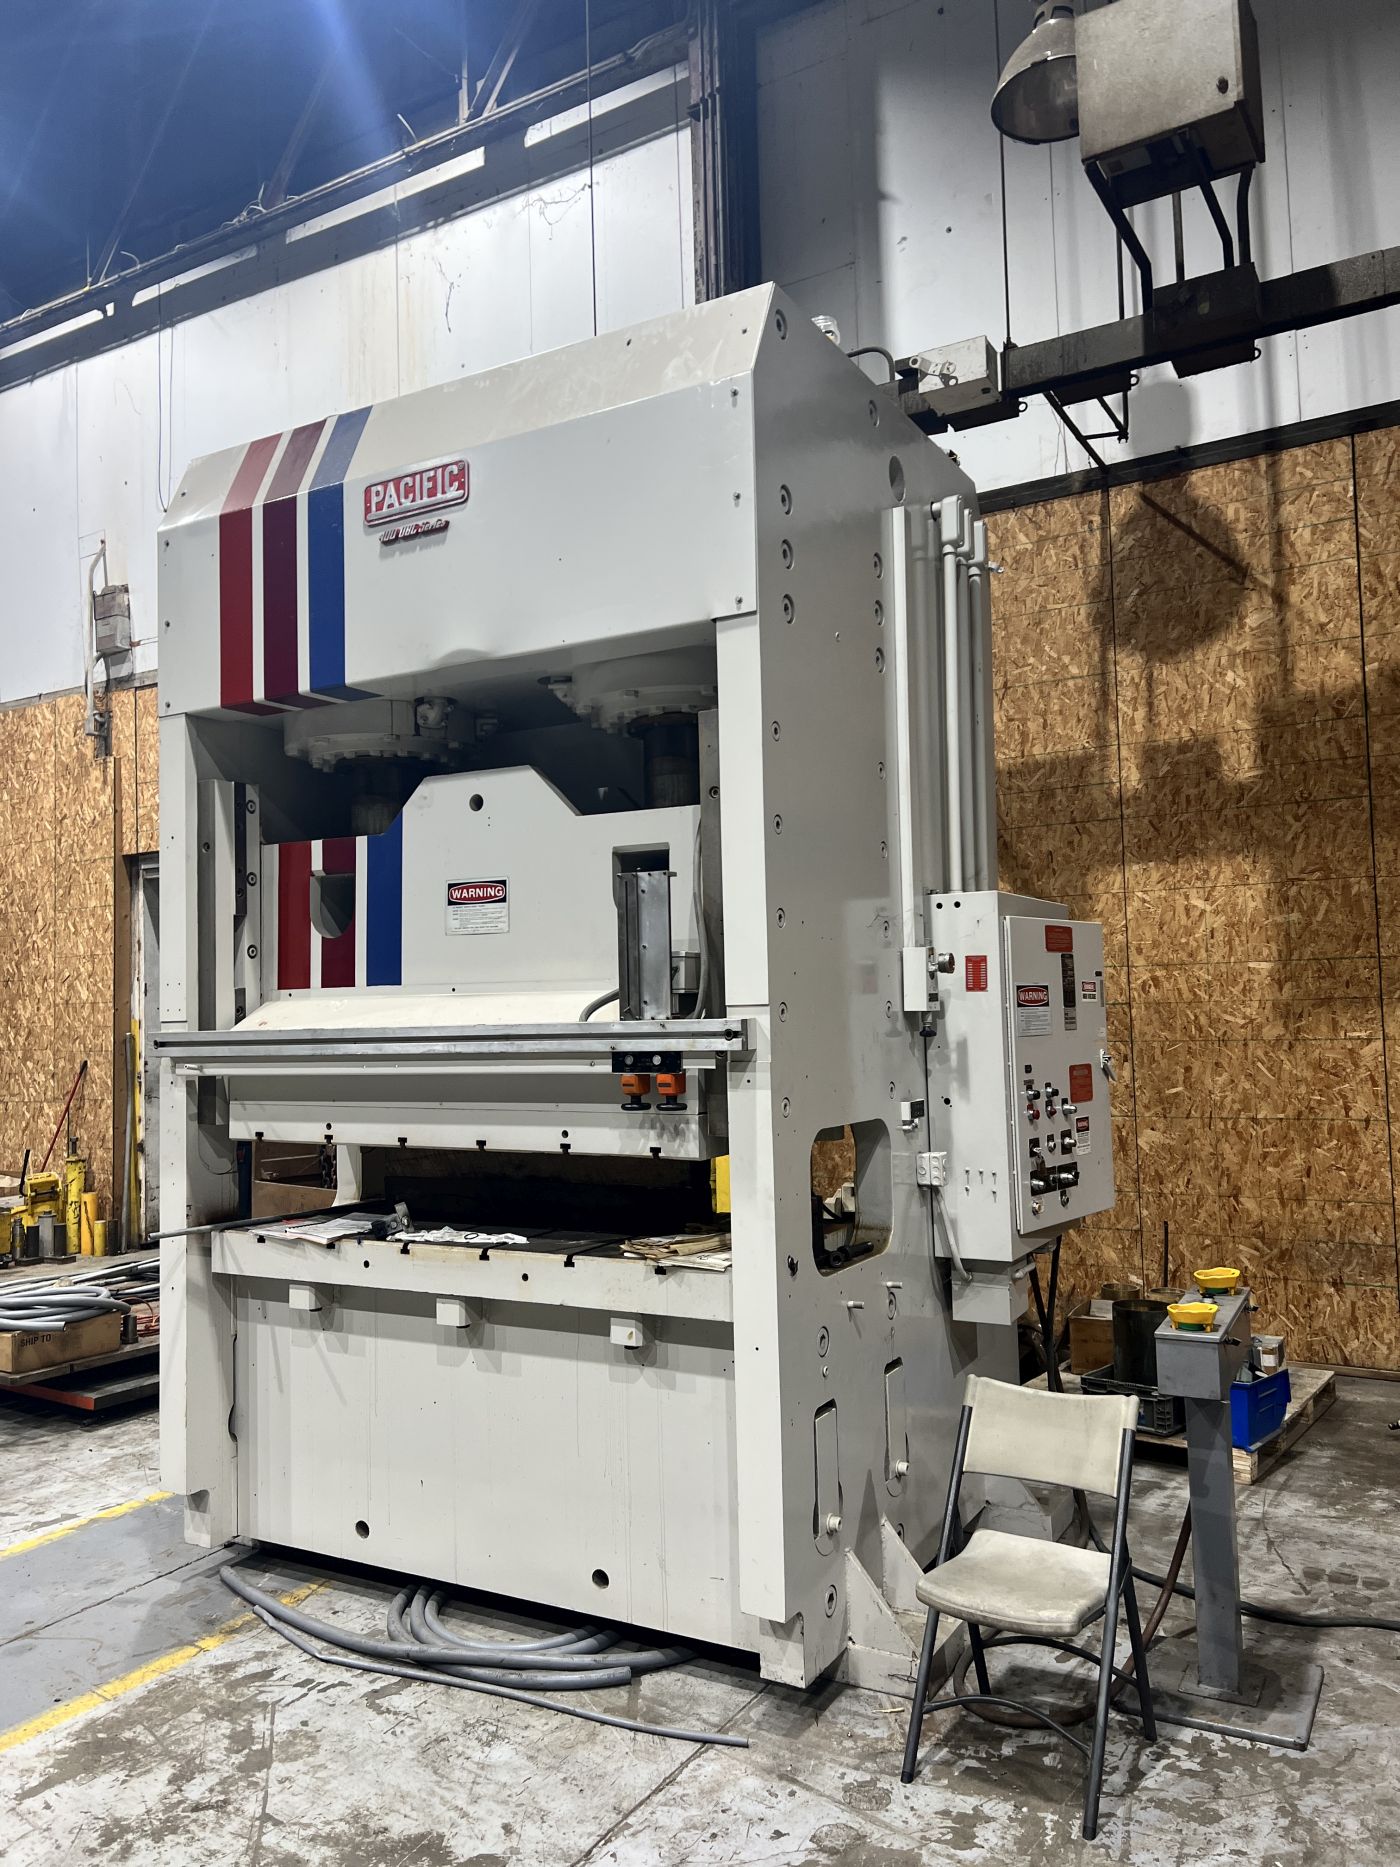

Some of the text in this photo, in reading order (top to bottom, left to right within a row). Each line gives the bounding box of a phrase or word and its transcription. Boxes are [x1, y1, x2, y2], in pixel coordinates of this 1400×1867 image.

[371, 465, 458, 513] PACIFIC
[452, 887, 503, 899] WARNING
[1018, 991, 1048, 1001] WARNING
[20, 1334, 51, 1347] SHIP TO
